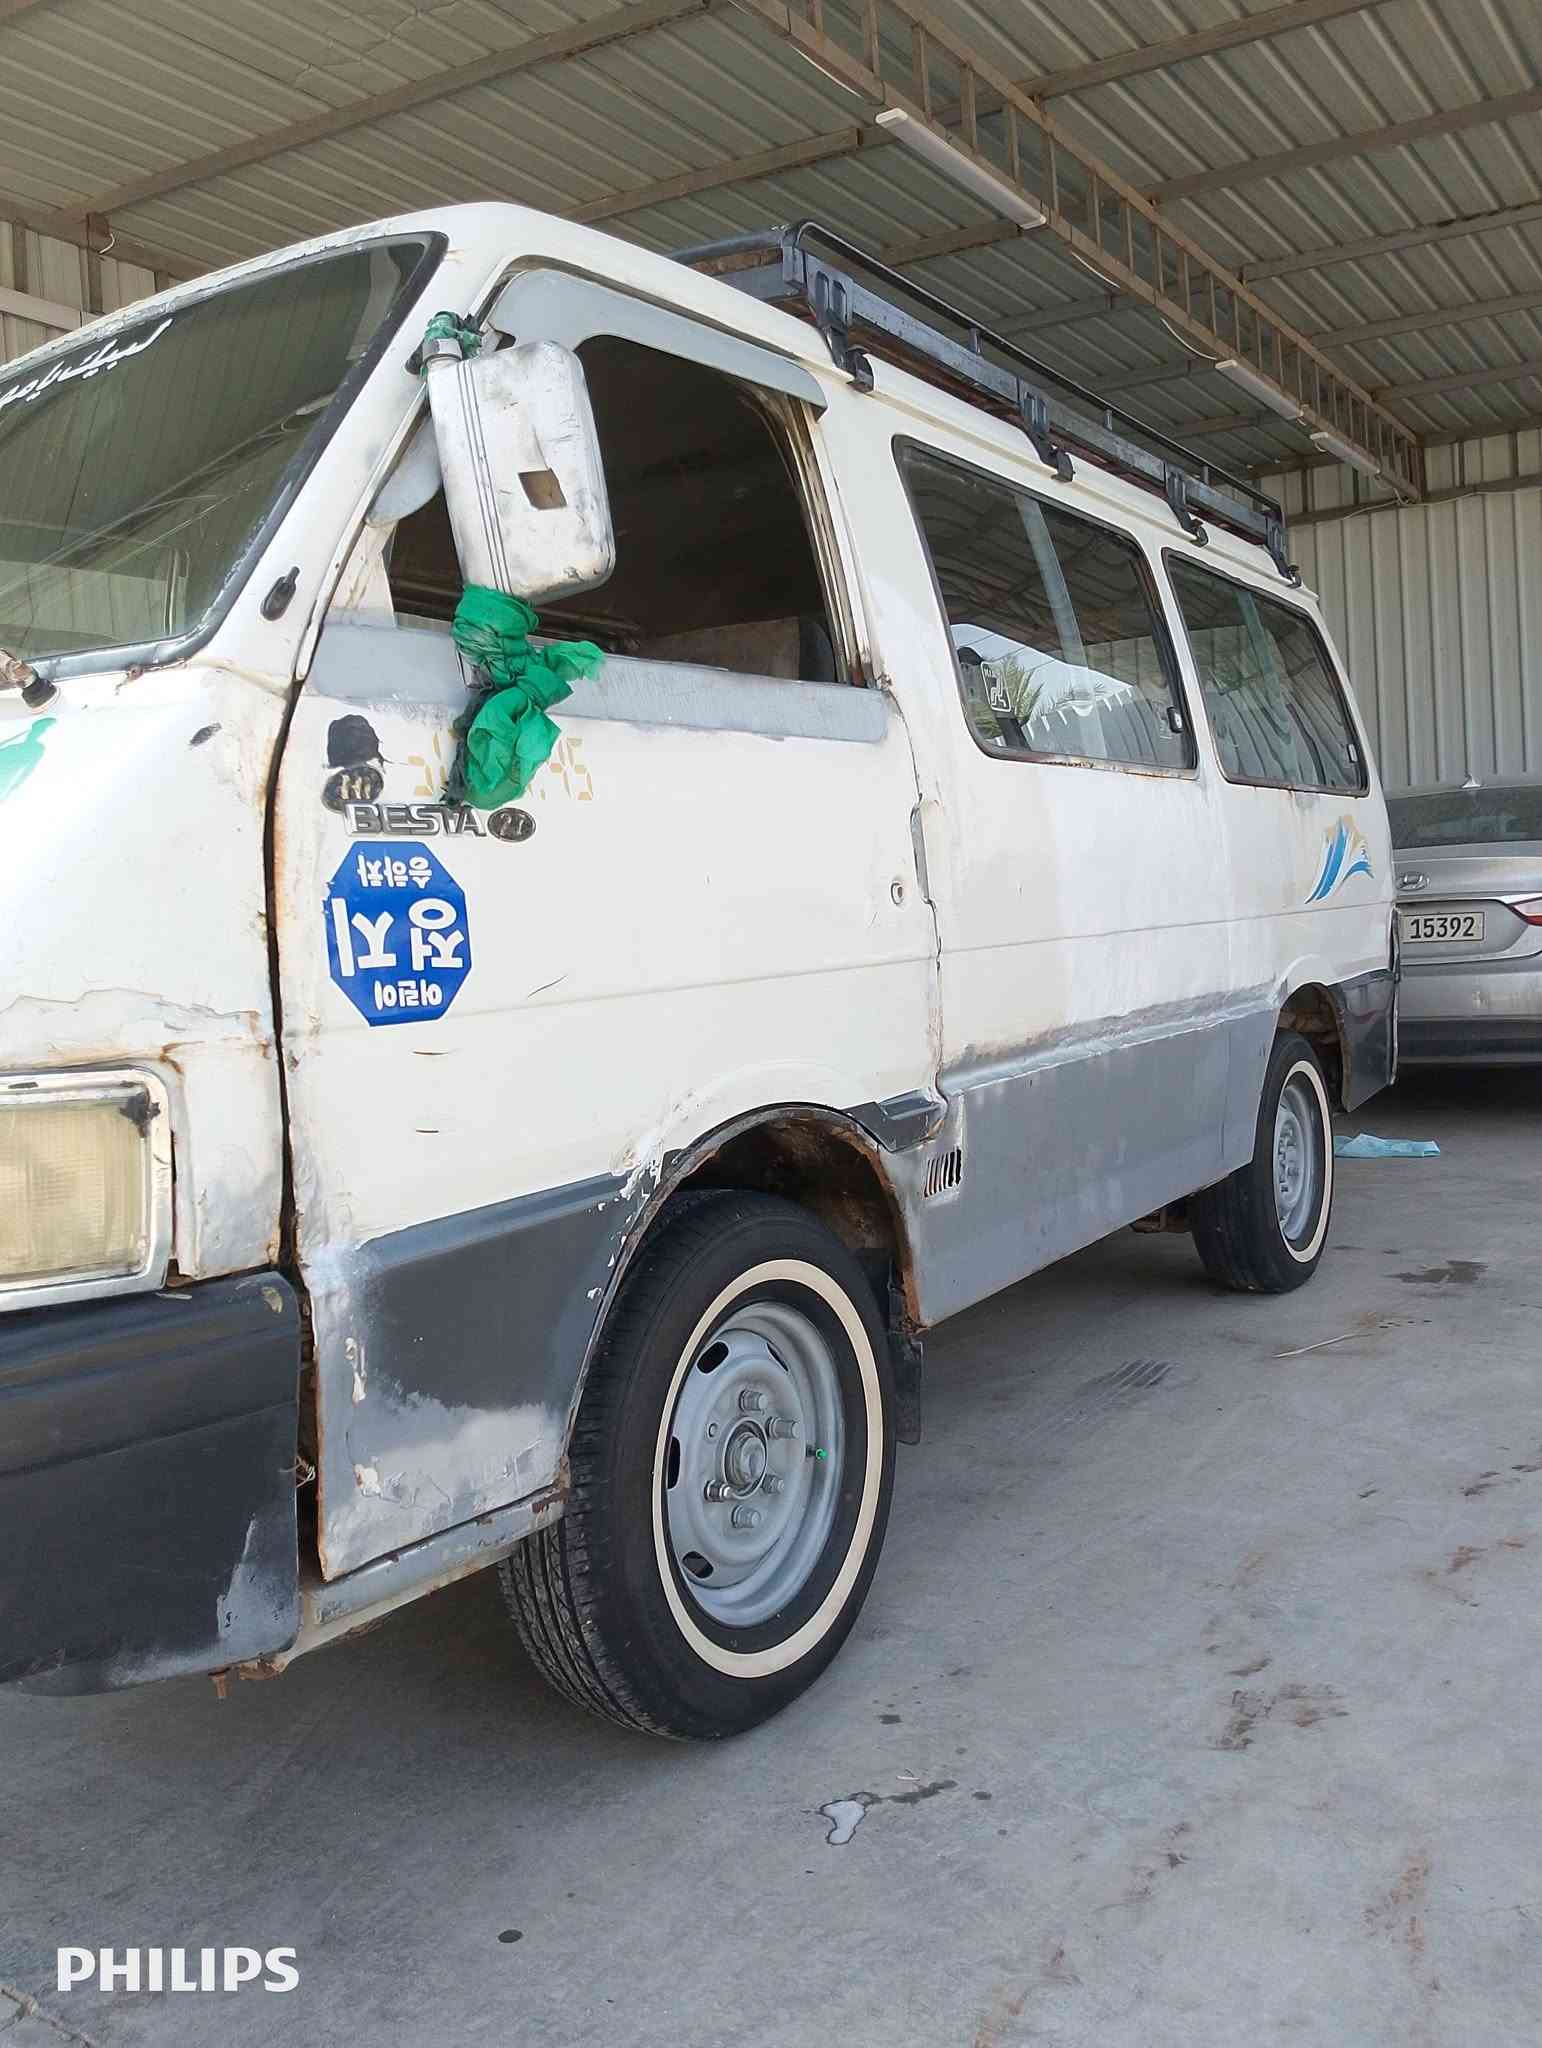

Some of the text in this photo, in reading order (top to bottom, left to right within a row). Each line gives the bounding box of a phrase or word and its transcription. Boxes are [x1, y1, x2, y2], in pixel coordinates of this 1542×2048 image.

[344, 802, 487, 837] BESTA
[357, 853, 433, 889] 승하차
[1410, 916, 1475, 939] 15392
[374, 978, 443, 1011] 어린이
